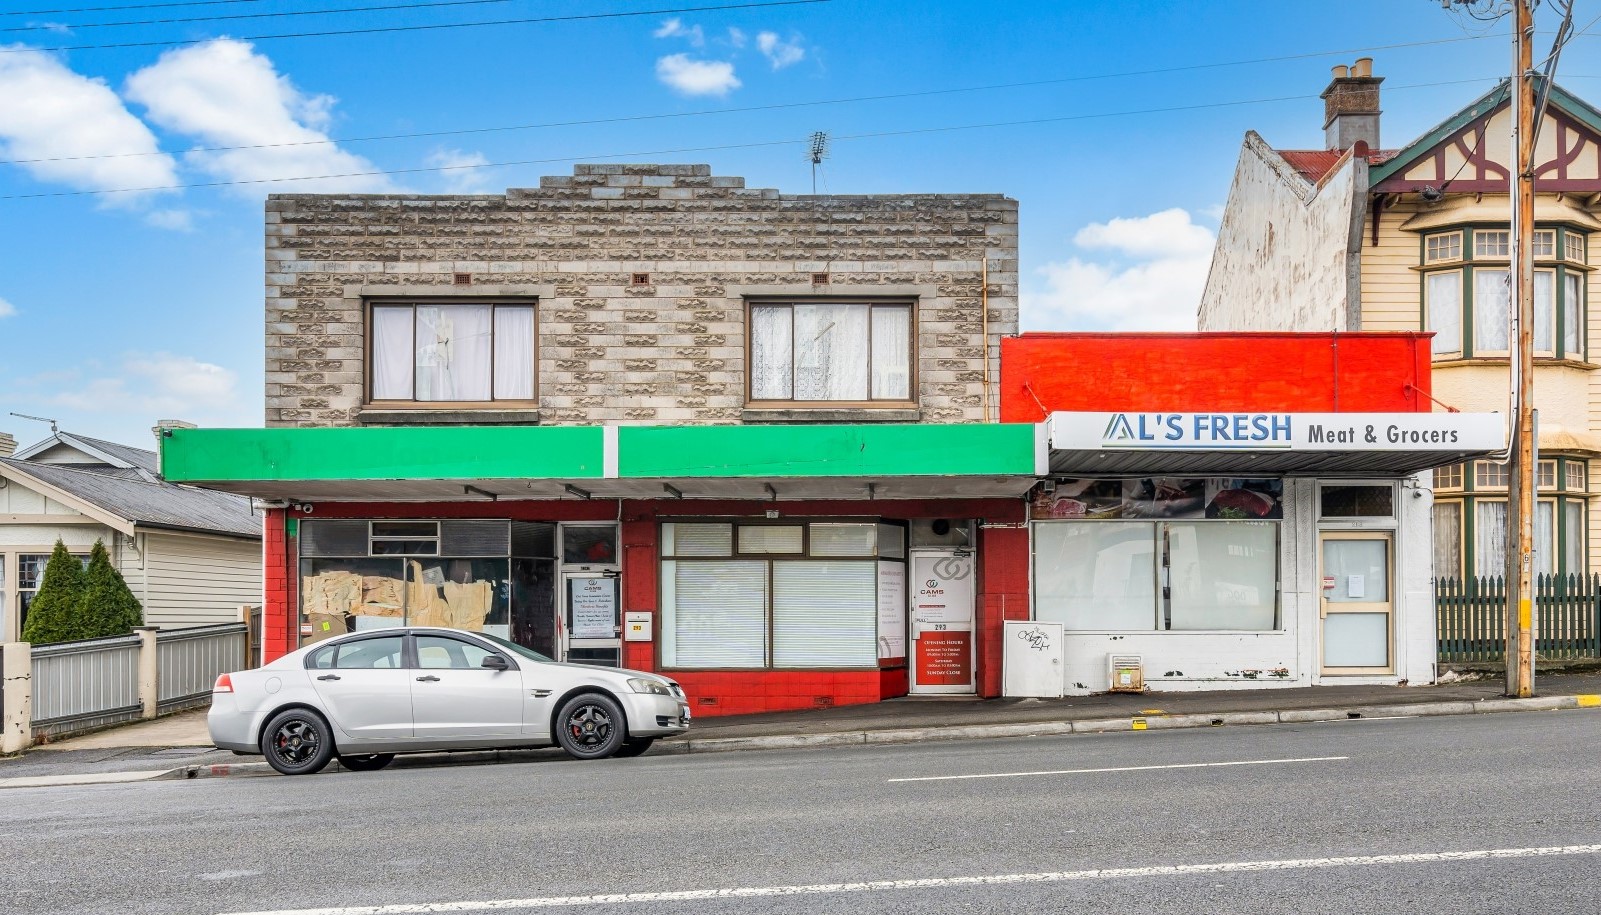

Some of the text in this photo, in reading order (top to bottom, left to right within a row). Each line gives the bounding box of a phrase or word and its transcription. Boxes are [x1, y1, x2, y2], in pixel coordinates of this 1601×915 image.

[1102, 413, 1292, 441] AL'S FRESH
[1308, 424, 1459, 443] Meat & Grocers
